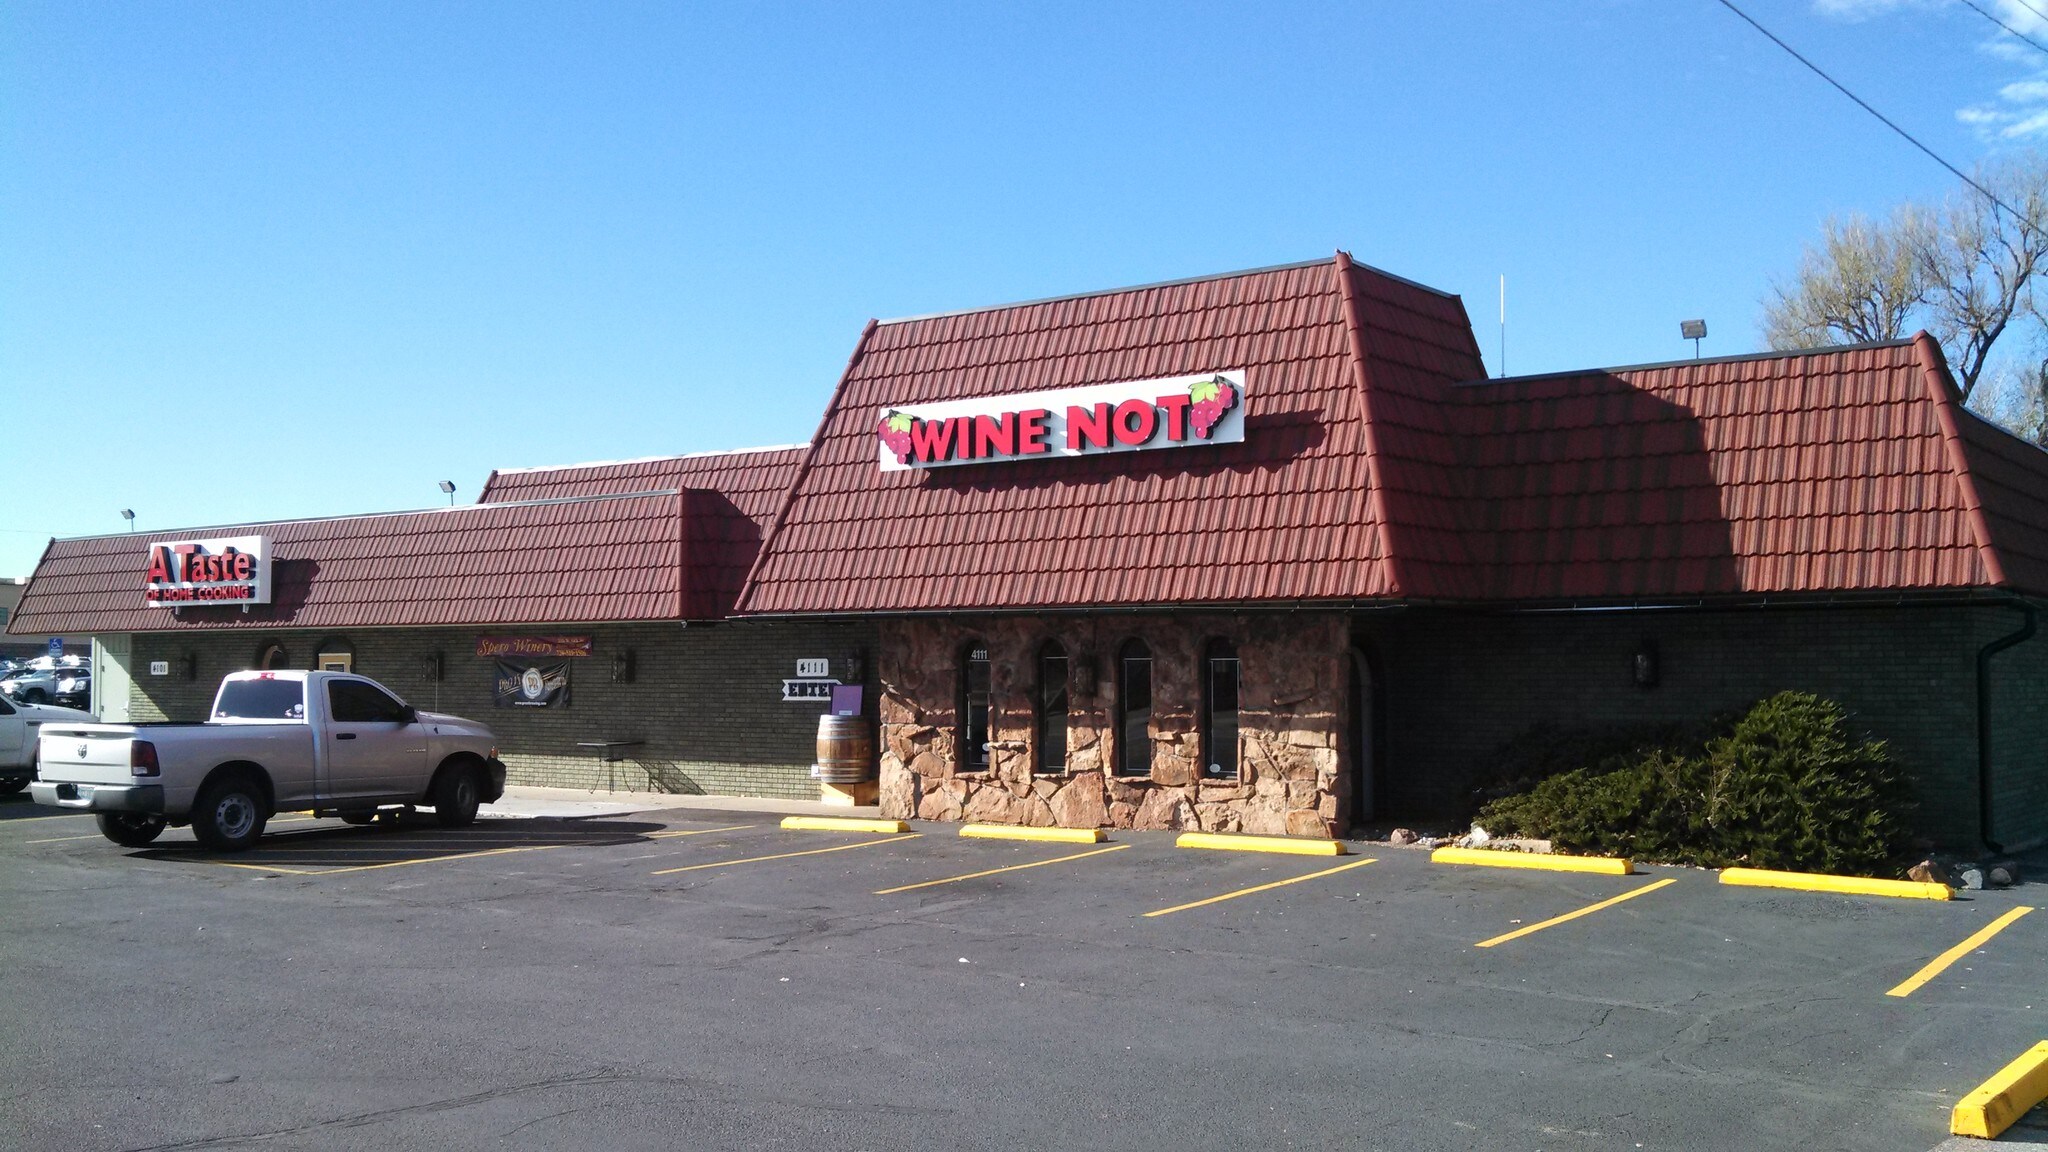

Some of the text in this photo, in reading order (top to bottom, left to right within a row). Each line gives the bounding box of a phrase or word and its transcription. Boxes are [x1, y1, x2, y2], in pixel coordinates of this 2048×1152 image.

[911, 394, 1190, 463] WINE NOT
[146, 544, 252, 583] A Taste
[146, 585, 250, 601] OF HOME COOKING
[476, 639, 509, 656] Spero
[514, 639, 553, 655] Winery
[971, 649, 987, 660] 4111
[153, 664, 166, 673] 4101
[799, 662, 824, 673] 4111
